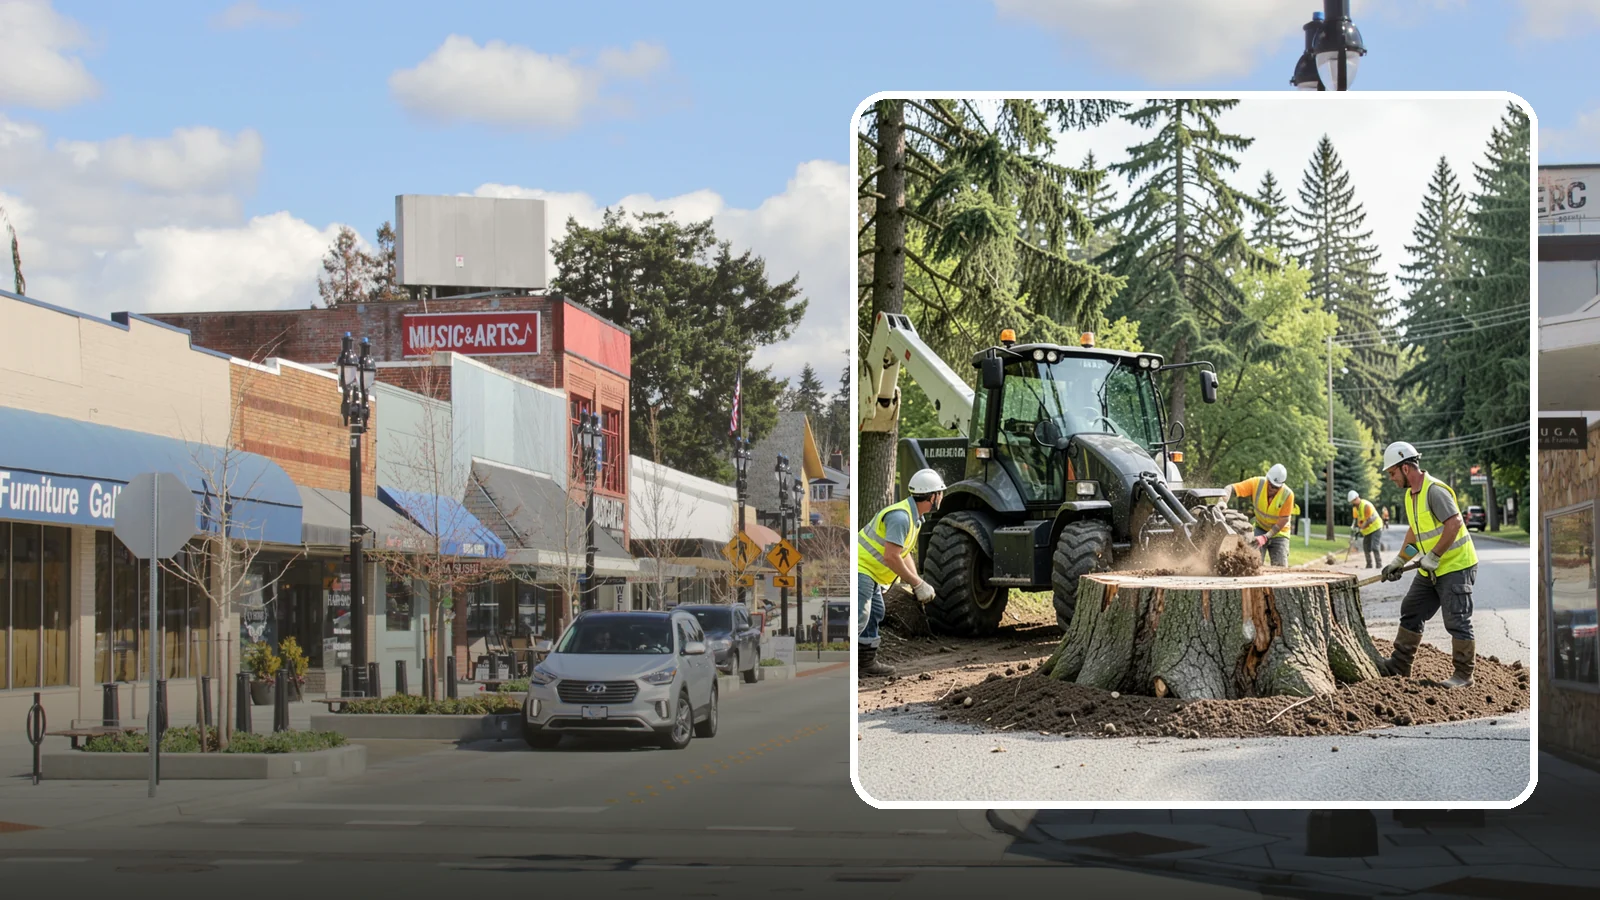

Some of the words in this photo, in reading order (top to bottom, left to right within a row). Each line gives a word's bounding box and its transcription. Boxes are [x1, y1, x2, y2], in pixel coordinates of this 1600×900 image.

[1538, 181, 1587, 213] ERC
[408, 323, 520, 349] MUSIC&ARTS
[1540, 427, 1577, 436] UGA
[0, 471, 79, 515] Furniture
[89, 482, 122, 519] Gal
